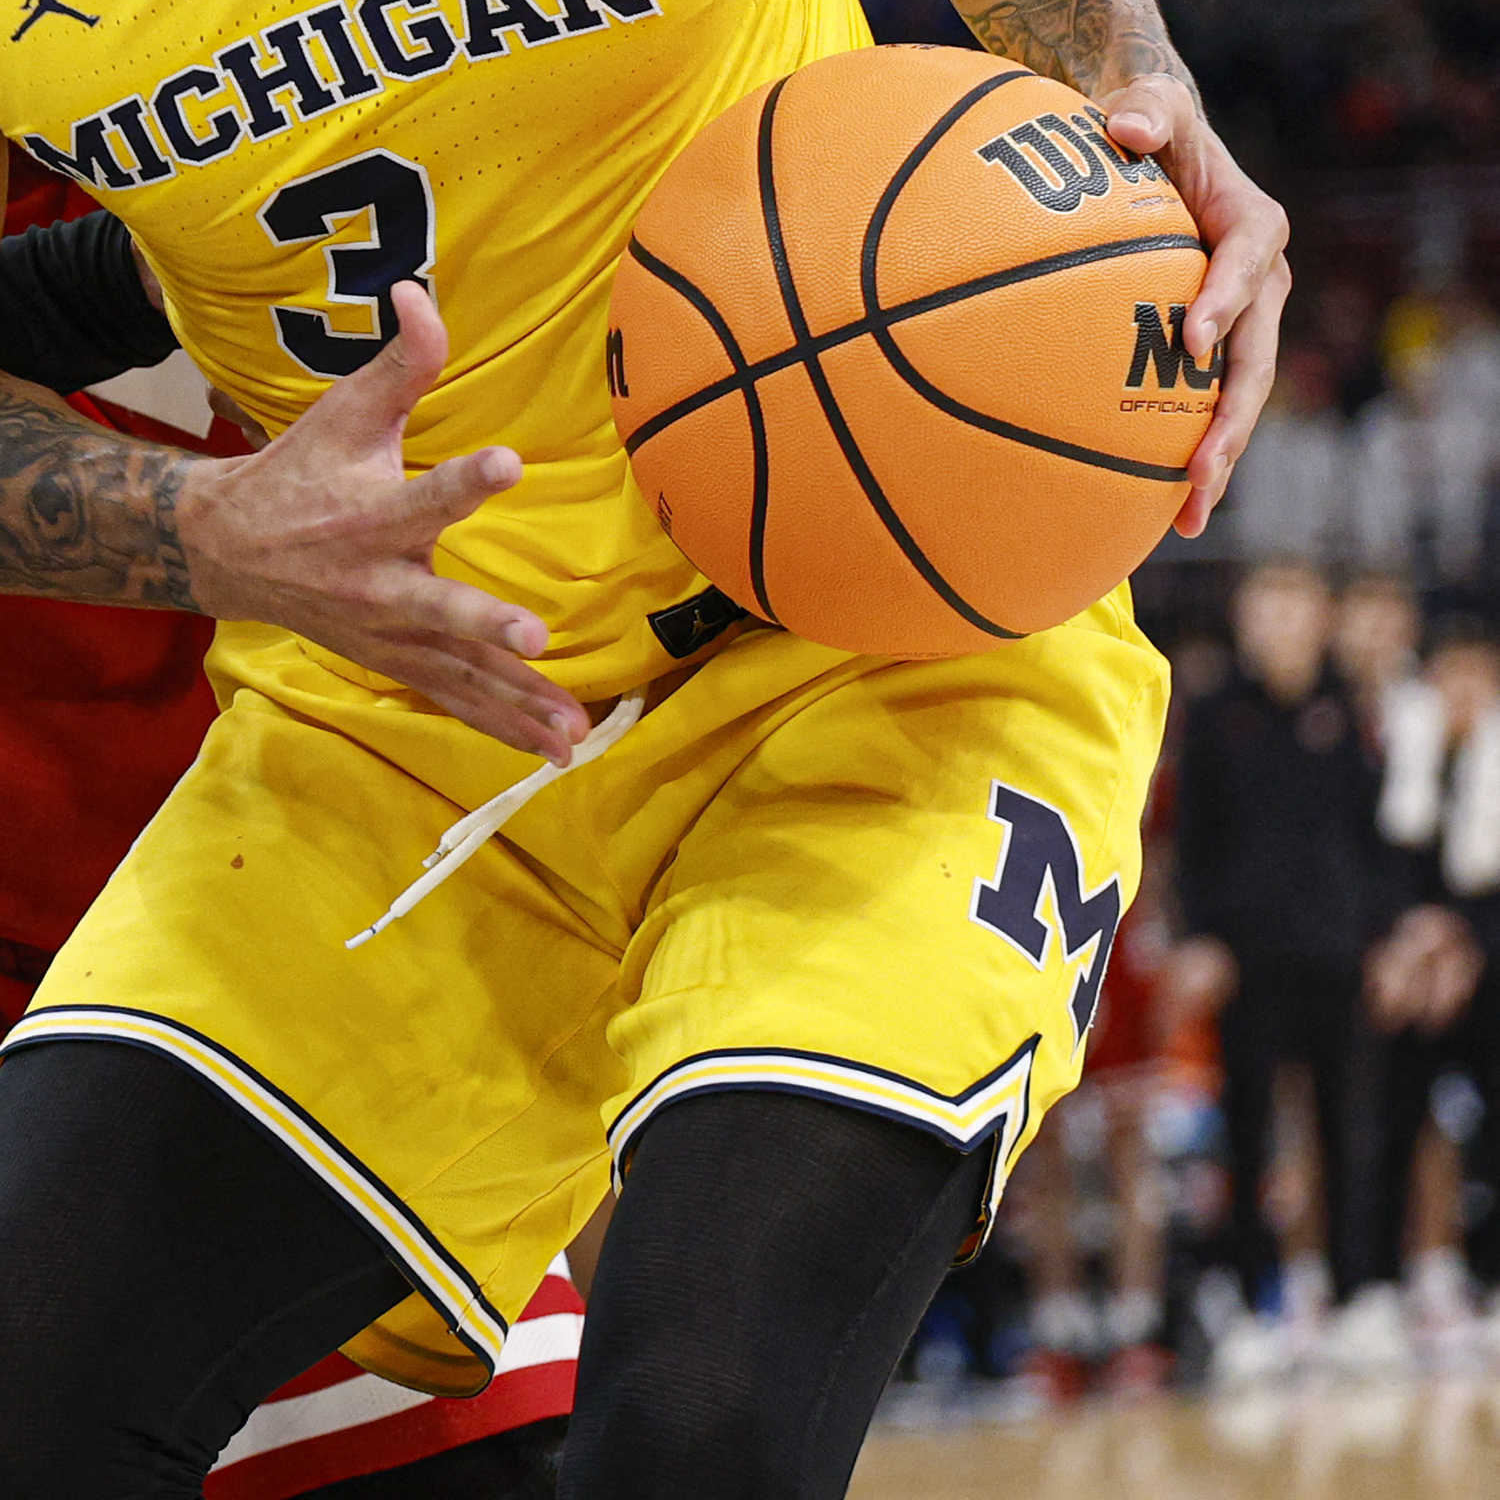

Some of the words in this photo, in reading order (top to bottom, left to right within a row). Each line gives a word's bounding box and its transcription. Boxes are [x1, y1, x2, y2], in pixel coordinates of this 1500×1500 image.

[255, 147, 437, 378] 3
[1120, 400, 1193, 413] OFFICIAL
[968, 778, 1123, 1050] M
